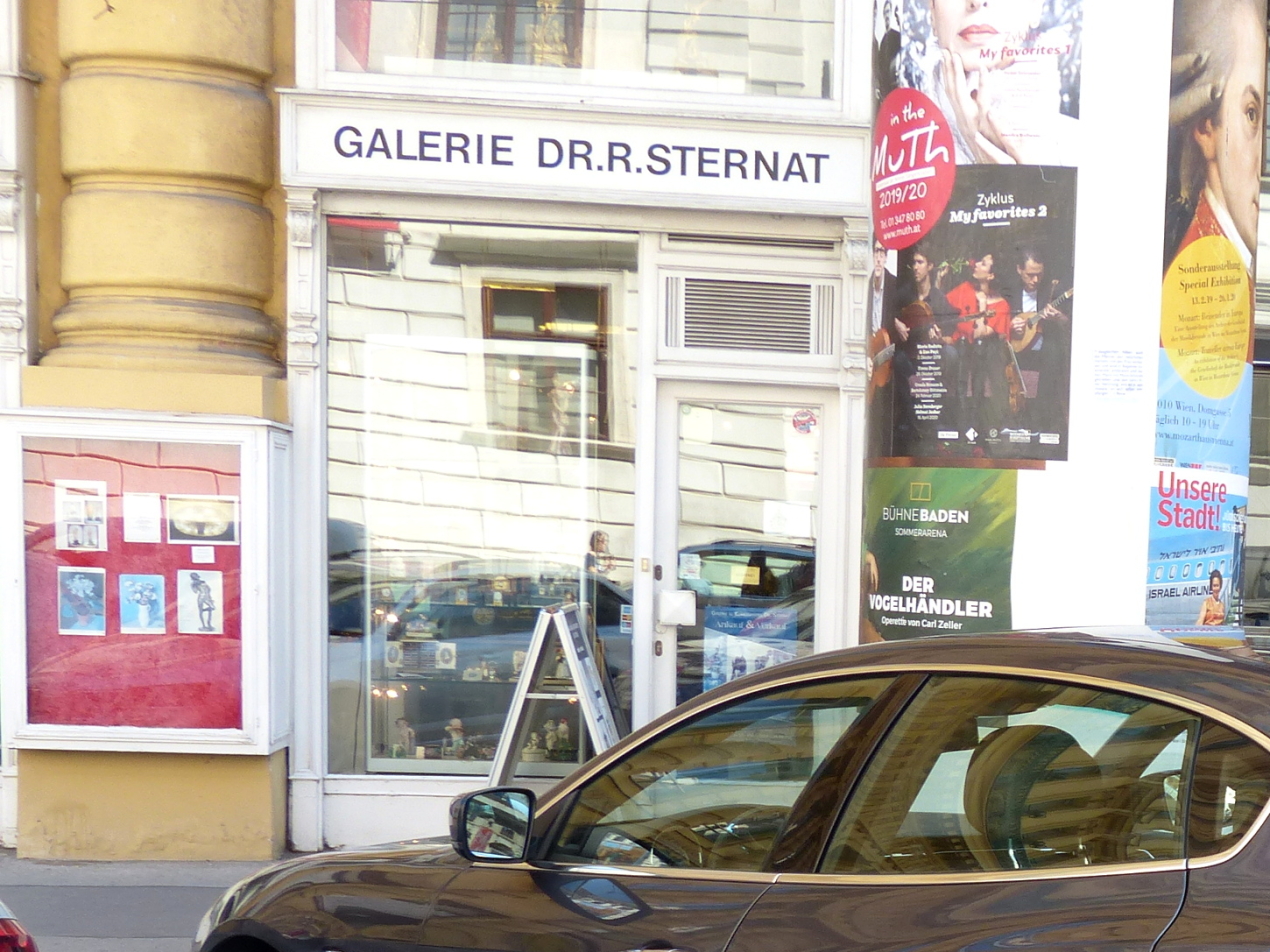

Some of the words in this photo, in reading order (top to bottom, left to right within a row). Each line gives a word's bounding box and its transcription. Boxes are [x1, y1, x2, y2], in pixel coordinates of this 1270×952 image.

[980, 48, 997, 60] My
[1001, 44, 1061, 60] favorites
[1065, 44, 1072, 55] 1
[890, 113, 900, 126] in
[902, 101, 926, 123] the
[333, 125, 514, 166] GALERIE
[538, 137, 830, 184] DR.R.STERNAT
[879, 182, 927, 209] 2019/20
[976, 192, 1015, 208] Zyklus
[895, 213, 906, 225] 347
[915, 210, 926, 220] 80
[949, 209, 972, 224] My
[972, 205, 1036, 223] favorites
[1037, 205, 1048, 217] 2
[883, 224, 921, 240] www.muth.at
[1178, 259, 1241, 275] Sonderausstellung
[1179, 277, 1209, 293] Special
[1210, 275, 1241, 288] Exhibition
[1157, 399, 1173, 410] 010
[1197, 403, 1227, 417] Domgasse
[1156, 414, 1179, 427] äglich
[1182, 416, 1191, 426] 10
[1199, 418, 1207, 428] 19
[1208, 419, 1220, 430] Uhr
[1158, 470, 1227, 503] Unsere
[1157, 499, 1221, 531] Stadt!
[895, 527, 948, 538] SOMMERARENA
[902, 575, 934, 593] DER
[1148, 587, 1181, 599] ISRAEL
[869, 593, 993, 618] VOGELHÄNDLER
[745, 620, 755, 629] &
[907, 619, 920, 627] von
[921, 618, 937, 628] Carl
[938, 620, 963, 630] Zeller
